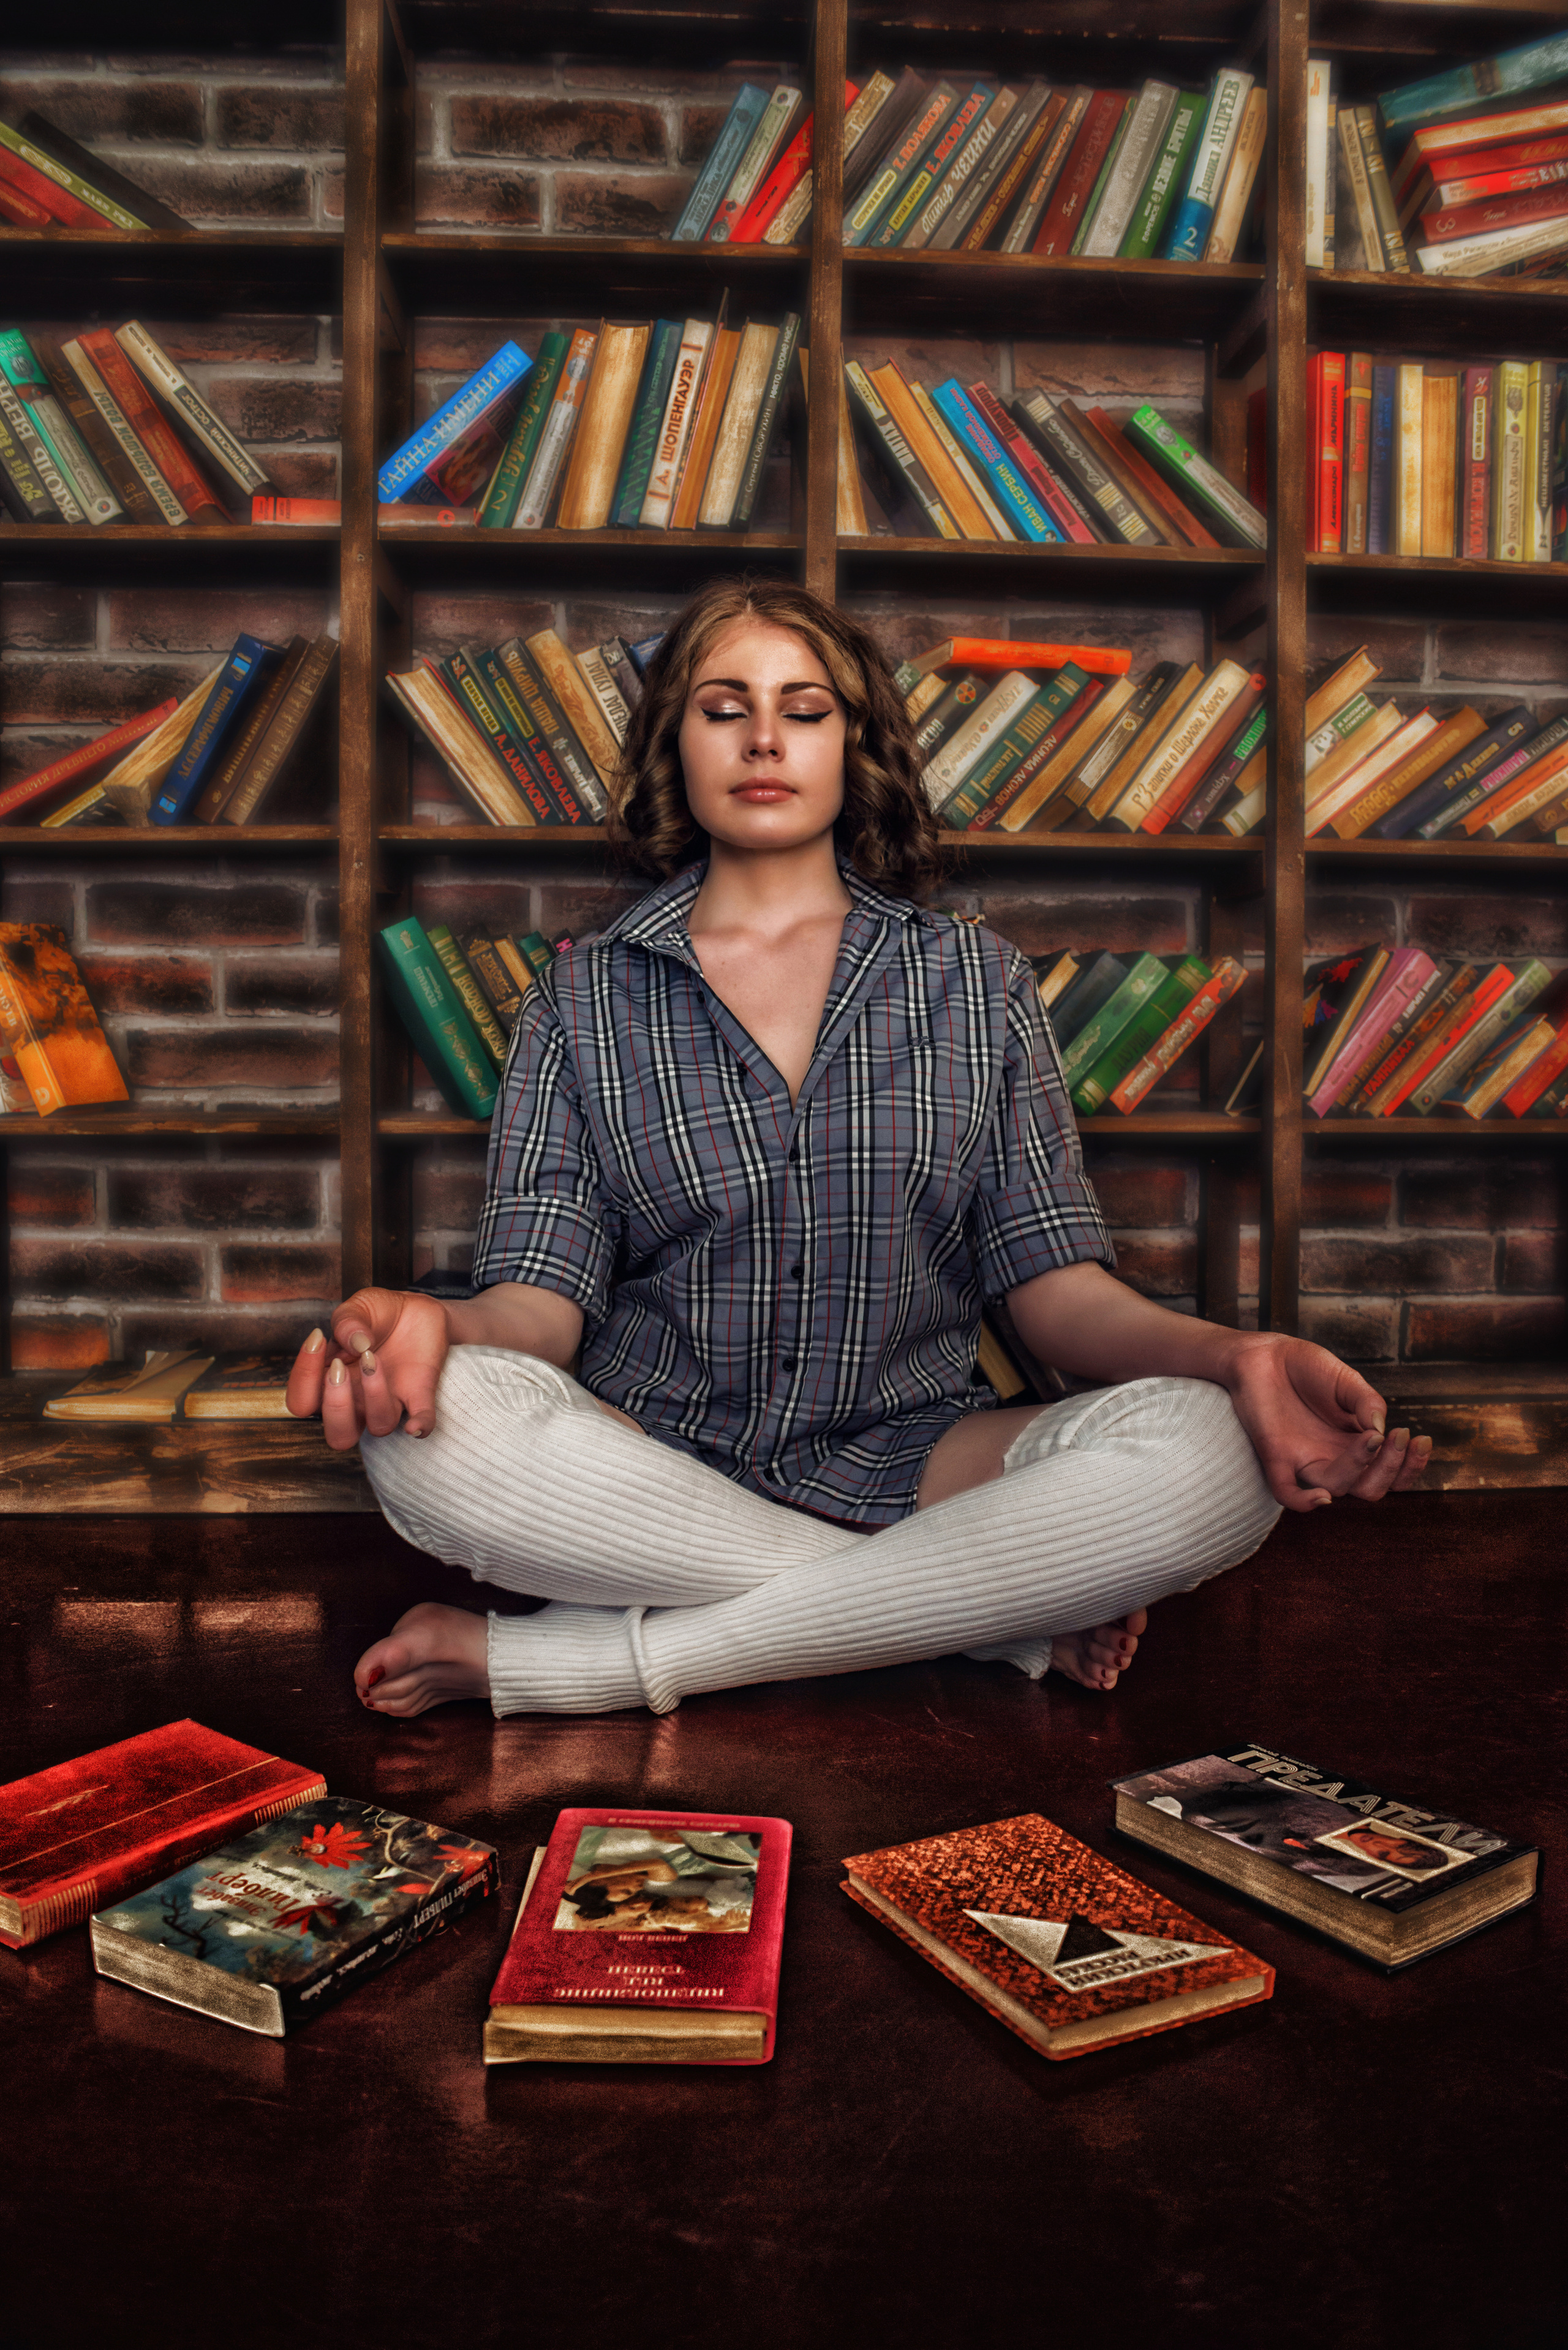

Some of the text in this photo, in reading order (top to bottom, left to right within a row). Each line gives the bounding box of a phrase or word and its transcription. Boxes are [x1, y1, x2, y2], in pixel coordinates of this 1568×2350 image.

[899, 92, 951, 161] ПОЛЯКОВА
[924, 91, 988, 174] Е. ЯКОВЛЕВА
[1194, 78, 1241, 202] Даниил АНДРЕЕВ
[1184, 226, 1199, 247] 2
[181, 391, 251, 477] ЧИТИНСКИЙ ОСТРОГ
[432, 369, 500, 440] ИМЕНИ
[659, 357, 697, 462] ШОПЕНГАУЭР
[752, 407, 772, 462] ГОВОРУХИН
[1330, 385, 1338, 445] МАРИНИНА
[93, 387, 181, 518] ВРЕМЯ БОЛЬШОЙ ВОДЫ
[655, 467, 669, 485] А.
[28, 444, 80, 523] ЖЮЛЬ
[995, 463, 1030, 505] СЕРБИН
[1022, 503, 1048, 533] ИВАН
[1468, 476, 1485, 555] КОРНИЛОВА
[503, 648, 559, 735] ПАША ЦИРУЛЬ
[586, 657, 612, 694] ГУЛАГ
[1171, 714, 1207, 757] Шерлоке
[1197, 684, 1228, 719] Холмсе
[49, 739, 107, 780] ДРЕВНЕГО
[494, 731, 552, 818] А. ДАНИЛОВА
[527, 736, 583, 823] Е. ЯКОВЛЕВА
[993, 733, 1058, 807] ЛЕОНИД ЛЕОНОВ
[453, 973, 494, 1022] ЛОНДОН
[1363, 1037, 1416, 1097] ГАННИБАЛ
[1227, 1750, 1508, 1856] ПРЕДАТЕЛИ
[197, 1887, 266, 1916] Элизабет
[206, 1871, 298, 1913] Гилберт
[413, 1892, 455, 1929] ГИЛБЕРТ
[454, 1869, 489, 1898] Элизабет
[1055, 1949, 1140, 1980] РАССКАЗ
[1065, 1948, 1191, 1989] ИРКУТСКИЙ
